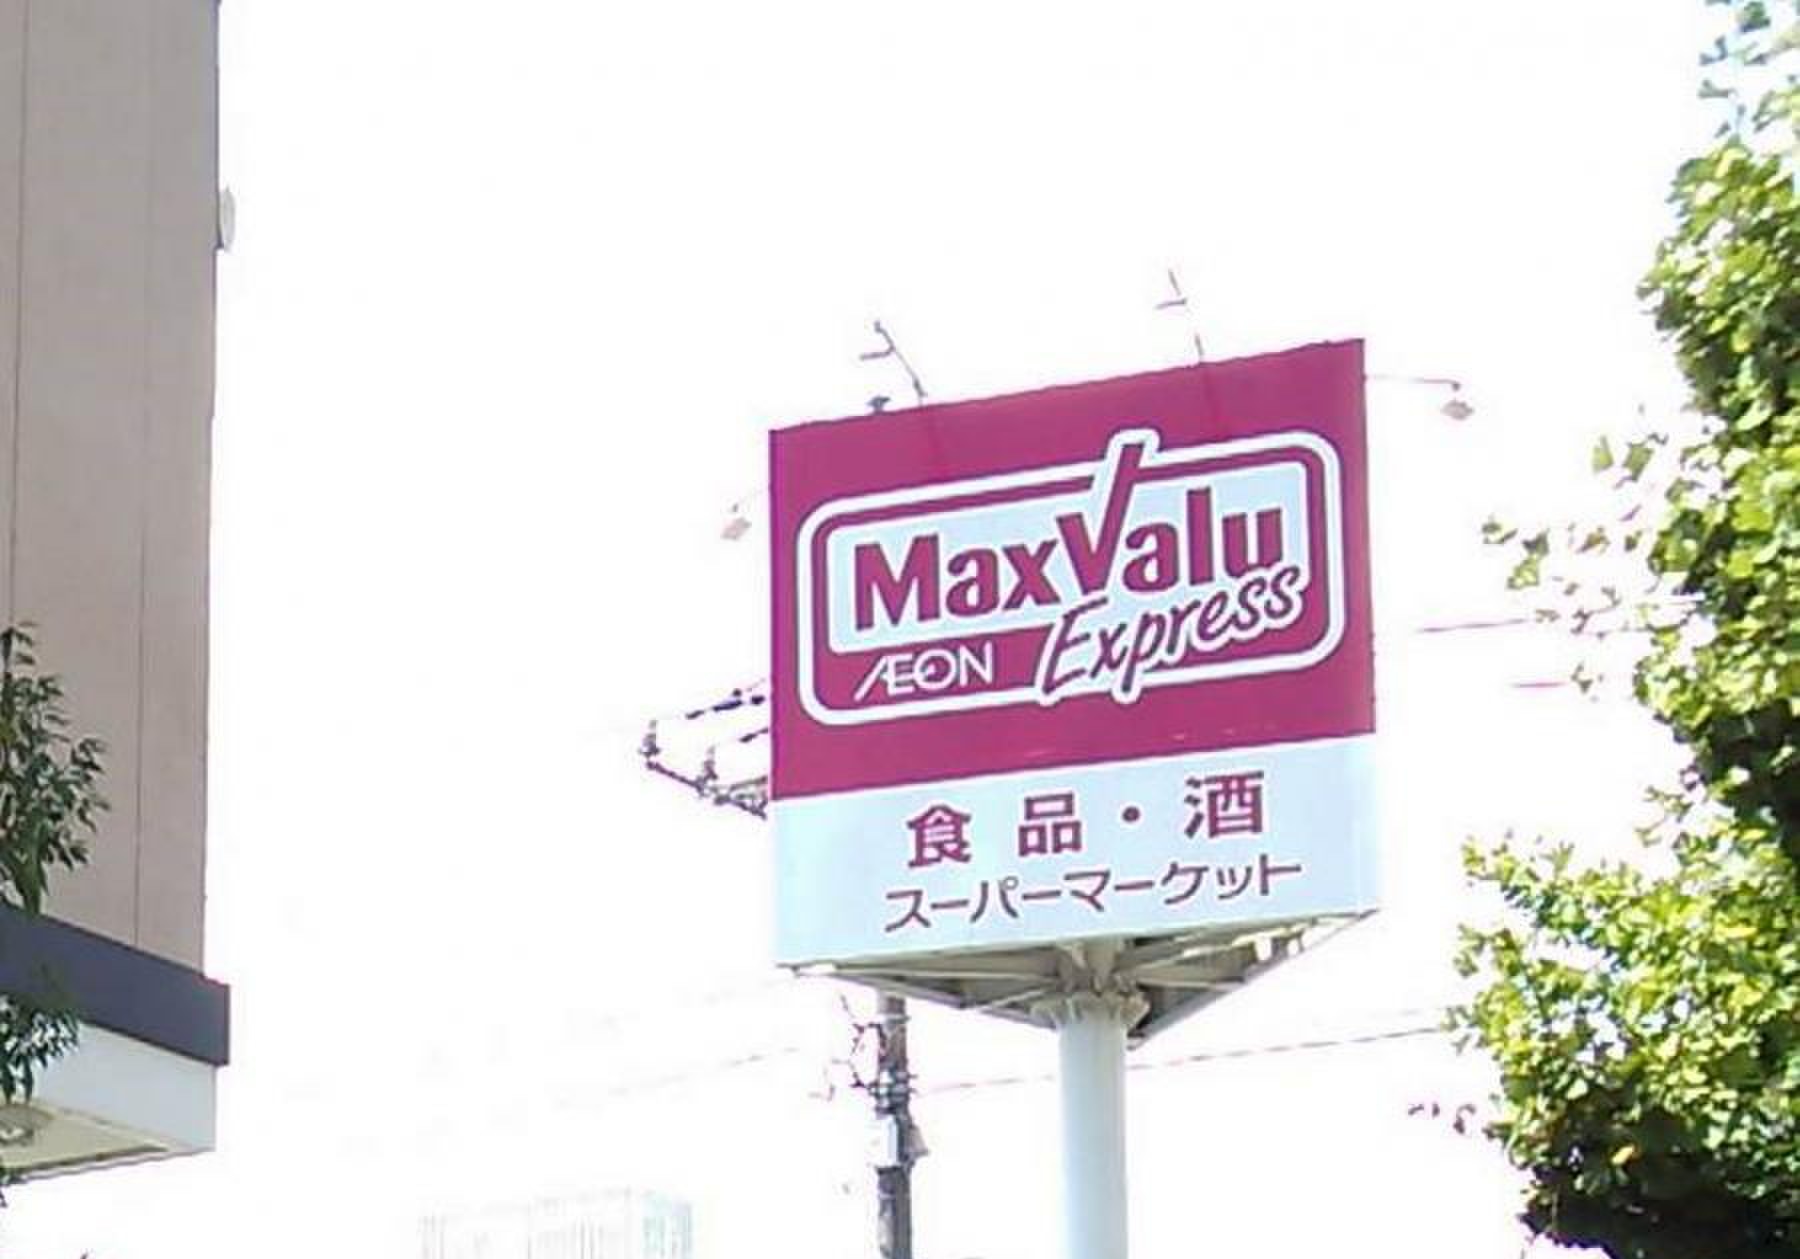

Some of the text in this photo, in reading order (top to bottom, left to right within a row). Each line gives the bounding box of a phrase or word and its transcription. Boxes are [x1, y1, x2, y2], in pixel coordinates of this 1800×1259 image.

[853, 443, 1284, 631] MaxValu
[1043, 566, 1301, 694] Express
[884, 854, 1302, 932] スーパーマーケット
